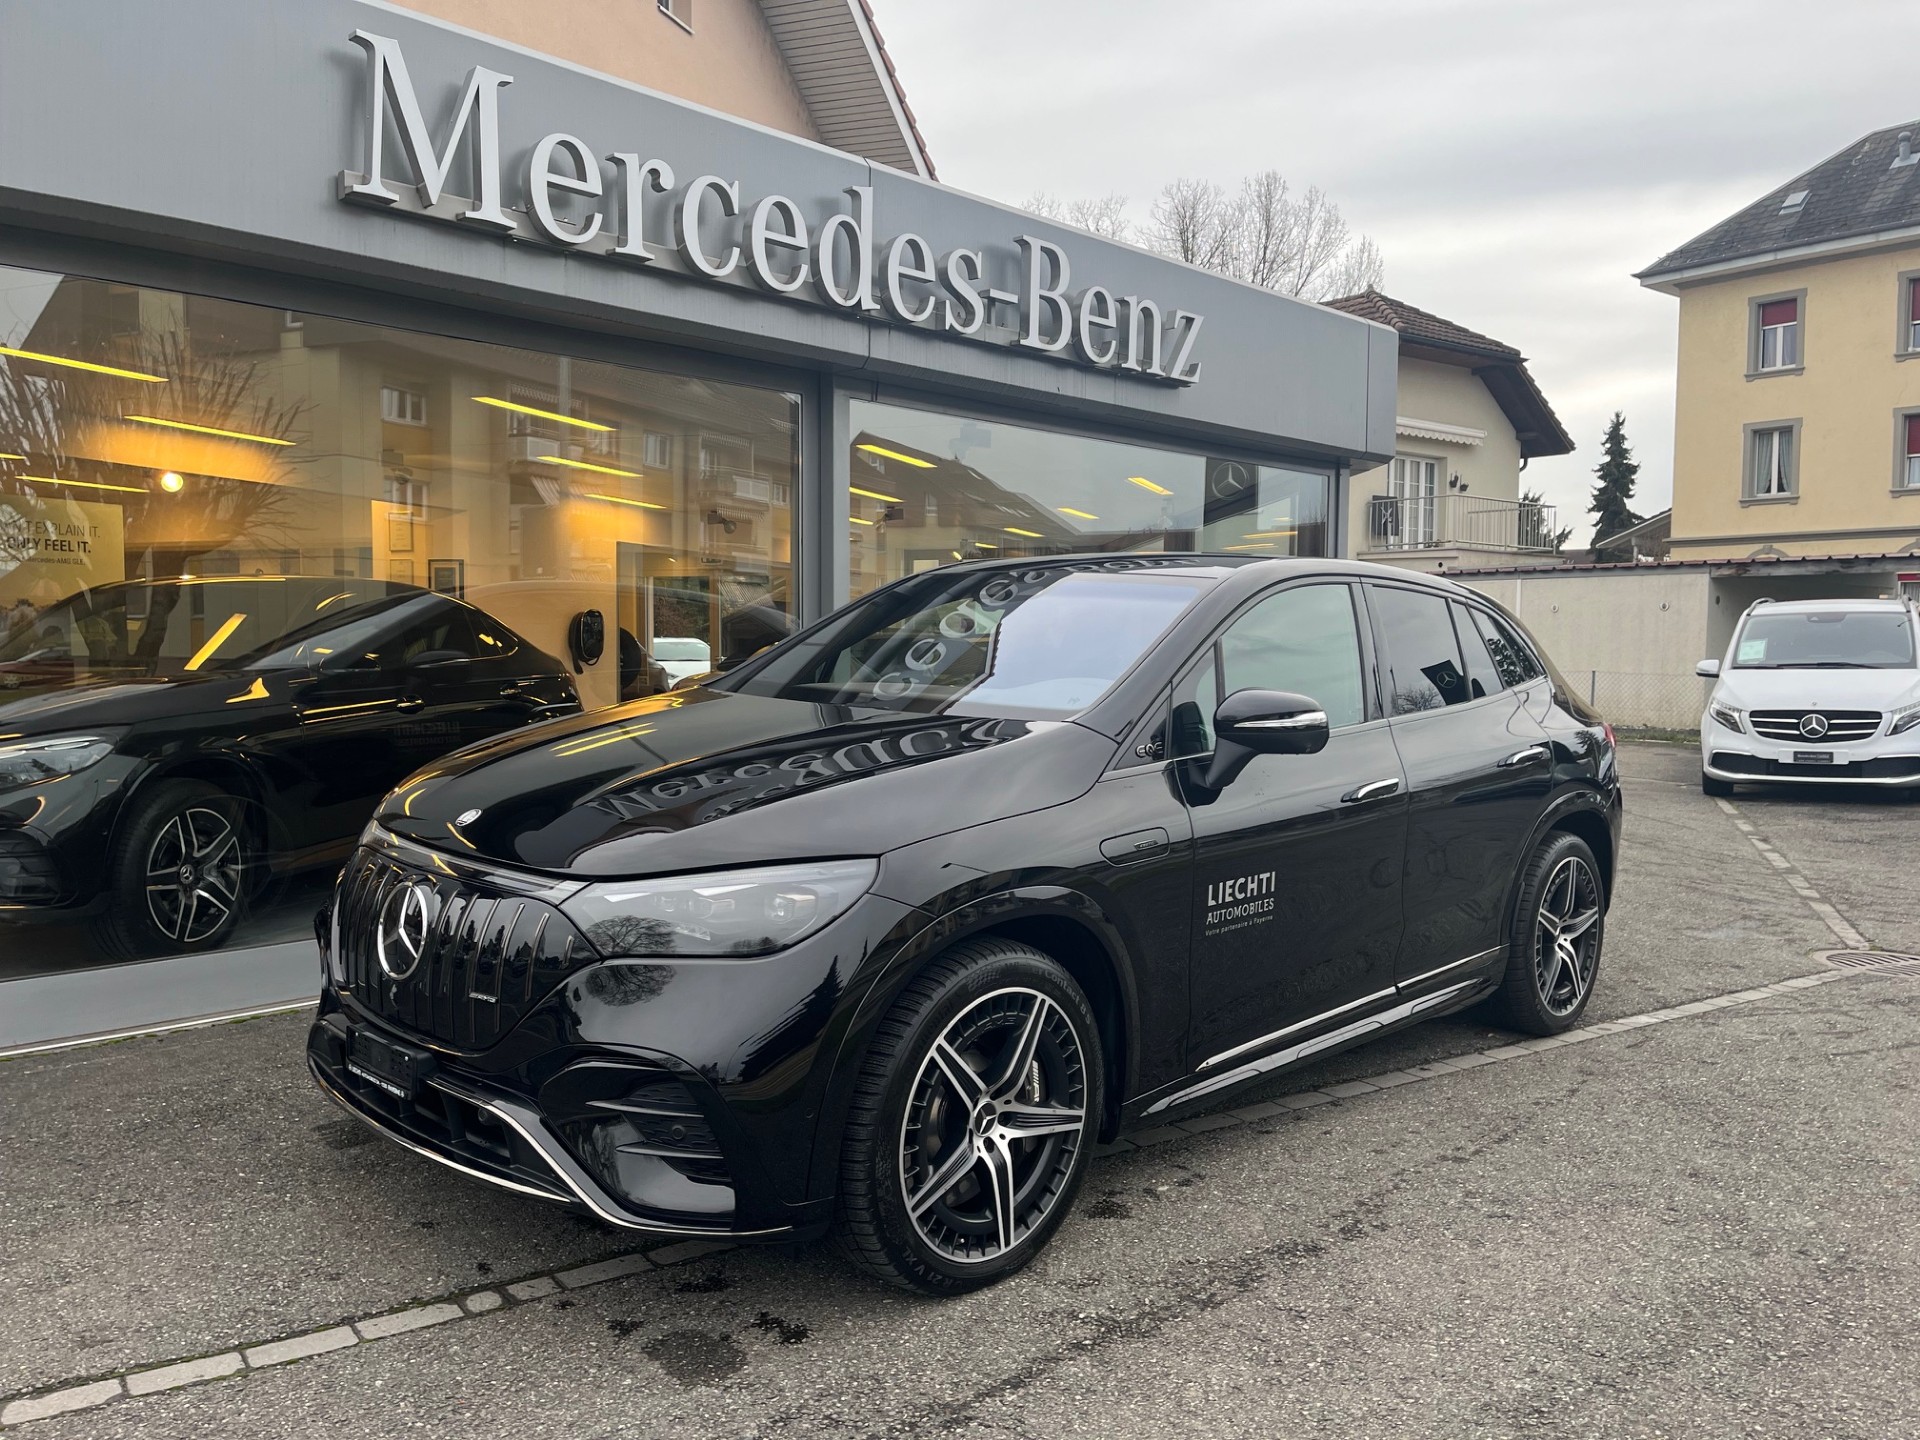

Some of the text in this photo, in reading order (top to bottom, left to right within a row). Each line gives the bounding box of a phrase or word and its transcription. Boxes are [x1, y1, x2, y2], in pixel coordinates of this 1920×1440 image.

[348, 28, 1205, 384] Mercedes-Benz
[35, 521, 85, 538] EXPLAIN
[89, 525, 101, 539] IT.
[45, 538, 75, 553] FEEL
[77, 541, 92, 554] IT.
[1135, 741, 1164, 758] EQE
[1208, 871, 1276, 907] LIECHTI
[1206, 898, 1275, 925] AUTOMOBILES
[1220, 921, 1248, 934] partenaire
